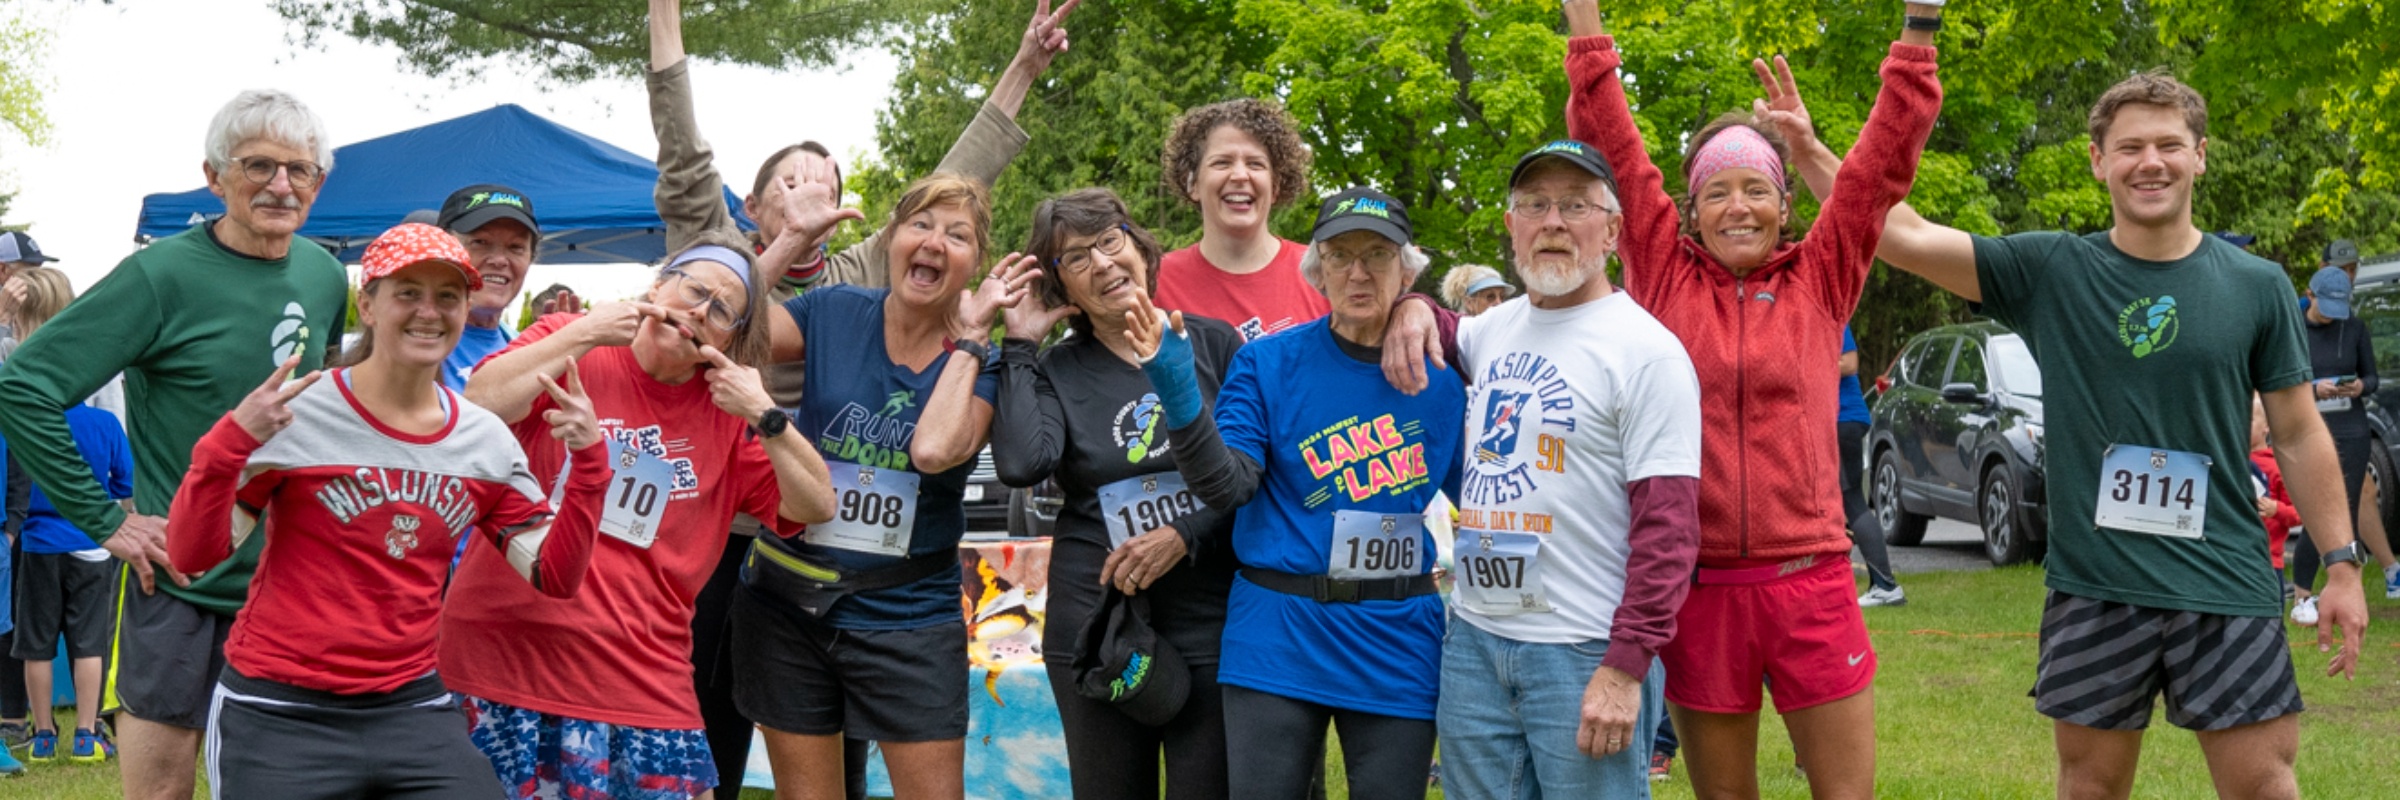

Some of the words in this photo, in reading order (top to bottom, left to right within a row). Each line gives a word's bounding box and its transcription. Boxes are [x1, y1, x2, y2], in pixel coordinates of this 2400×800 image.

[822, 400, 918, 450] RUN
[1302, 412, 1405, 480] LAKE
[820, 436, 841, 455] THE
[838, 433, 910, 471] DOOR
[1343, 441, 1428, 503] LAKE
[1536, 432, 1567, 474] 91
[315, 466, 477, 538] WISCONSIN
[612, 470, 658, 518] 10
[833, 487, 903, 529] 908
[2112, 469, 2194, 511] 3114
[1490, 511, 1516, 530] DAY
[1522, 513, 1553, 533] RUN
[1346, 536, 1415, 571] 1906
[1461, 555, 1526, 589] 1907
